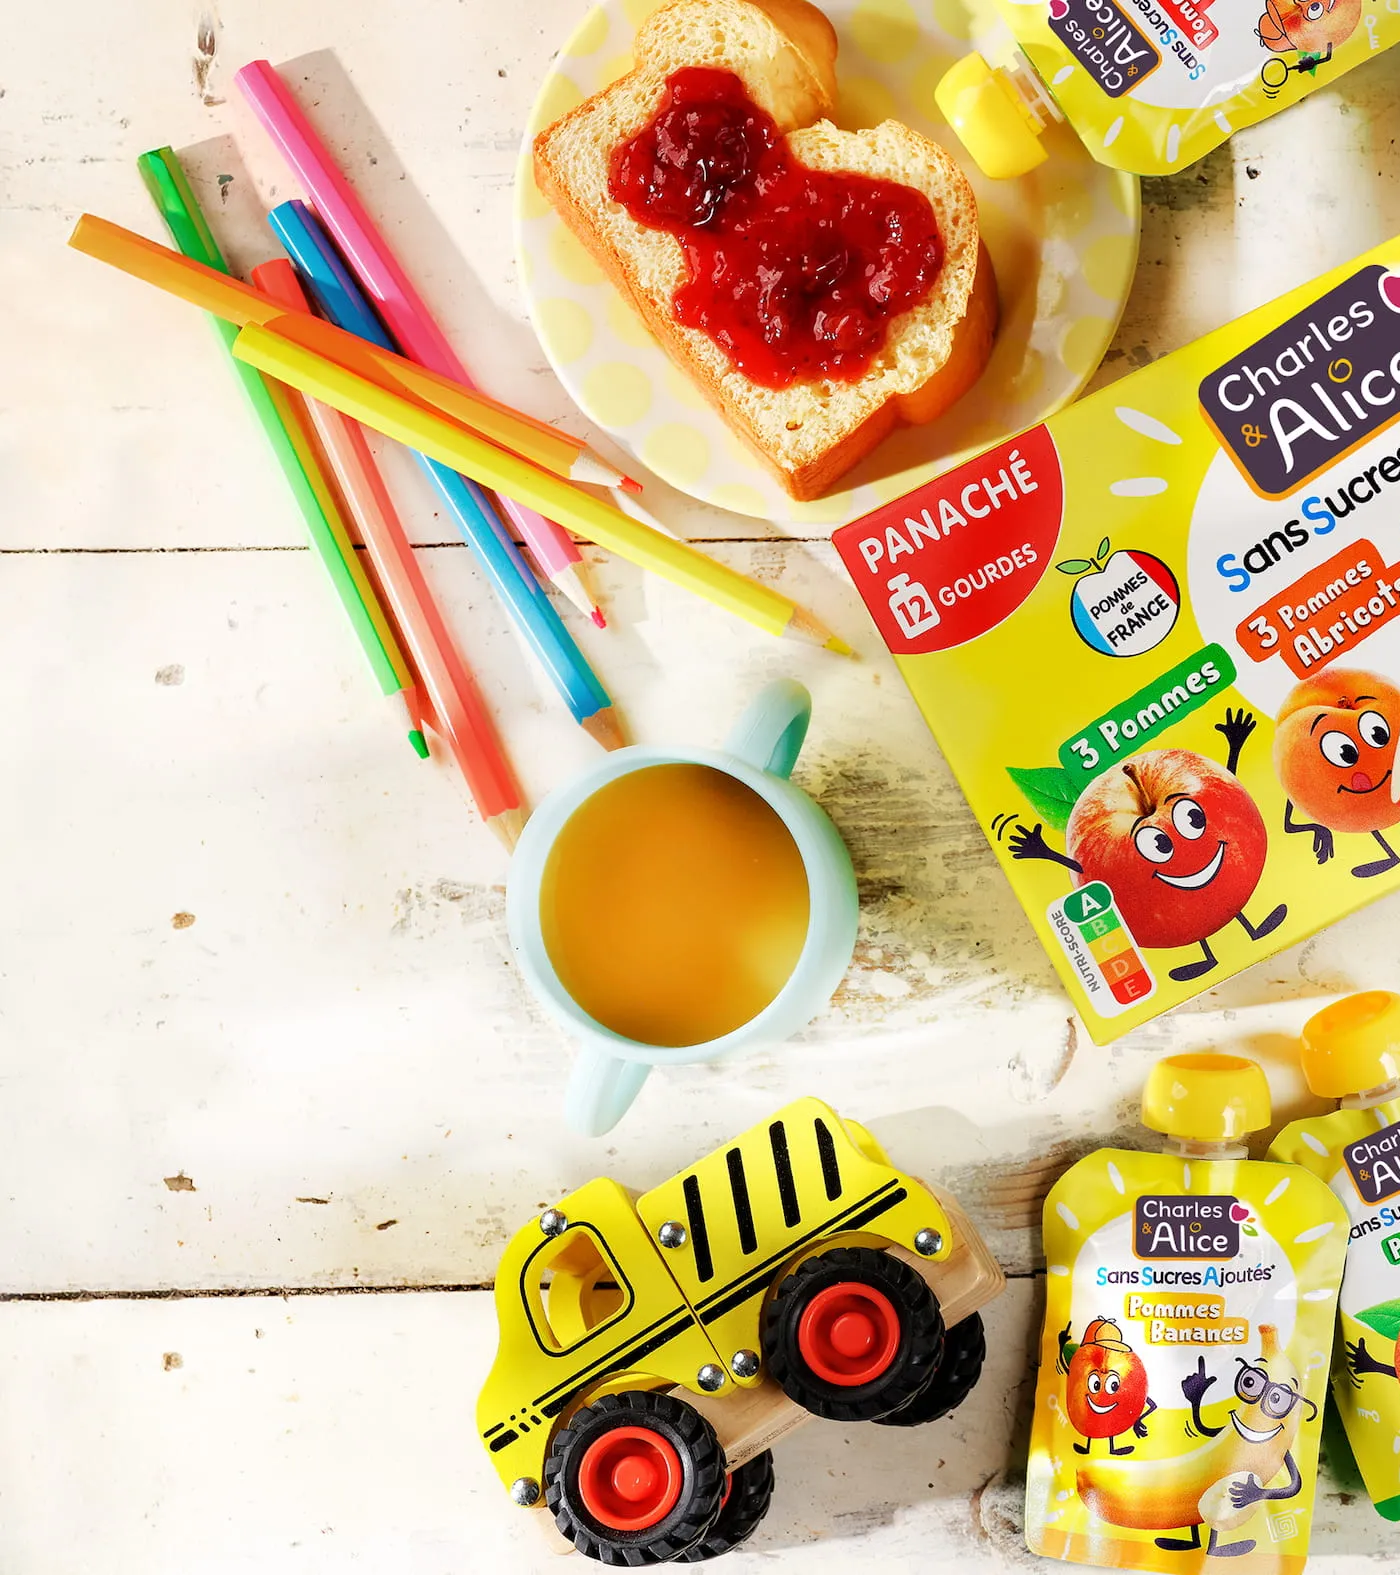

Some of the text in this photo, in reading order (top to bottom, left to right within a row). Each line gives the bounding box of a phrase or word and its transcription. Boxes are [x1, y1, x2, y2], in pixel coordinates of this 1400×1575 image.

[1086, 0, 1149, 77] & Alice
[1065, 20, 1123, 89] Charles
[1172, 40, 1206, 81] Sans
[1217, 299, 1376, 412] Charles
[1240, 423, 1268, 448] &
[858, 449, 1039, 574] PANACHÉ
[1215, 517, 1311, 593] Sans
[896, 543, 1038, 628] 12 GOURDES
[1090, 571, 1149, 620] POMMES
[1120, 600, 1135, 615] de
[1248, 559, 1372, 648] 3 Pommes
[1106, 594, 1170, 648] FRANCE
[1070, 661, 1221, 769] 3 Pommes
[1080, 892, 1102, 917] A
[1091, 919, 1108, 936] B
[1051, 910, 1101, 992] NUTRI-SCORE
[1101, 936, 1118, 953] C
[1111, 959, 1130, 977] D
[1124, 979, 1141, 998] E
[1359, 1169, 1372, 1181] &
[1143, 1200, 1223, 1218] Charles
[1141, 1221, 1228, 1253] & Alice
[1348, 1215, 1382, 1245] ans
[1096, 1266, 1140, 1286] Sans
[1141, 1266, 1202, 1286] Sucres
[1128, 1295, 1221, 1319] Pommes
[1151, 1320, 1245, 1343] Bananes
